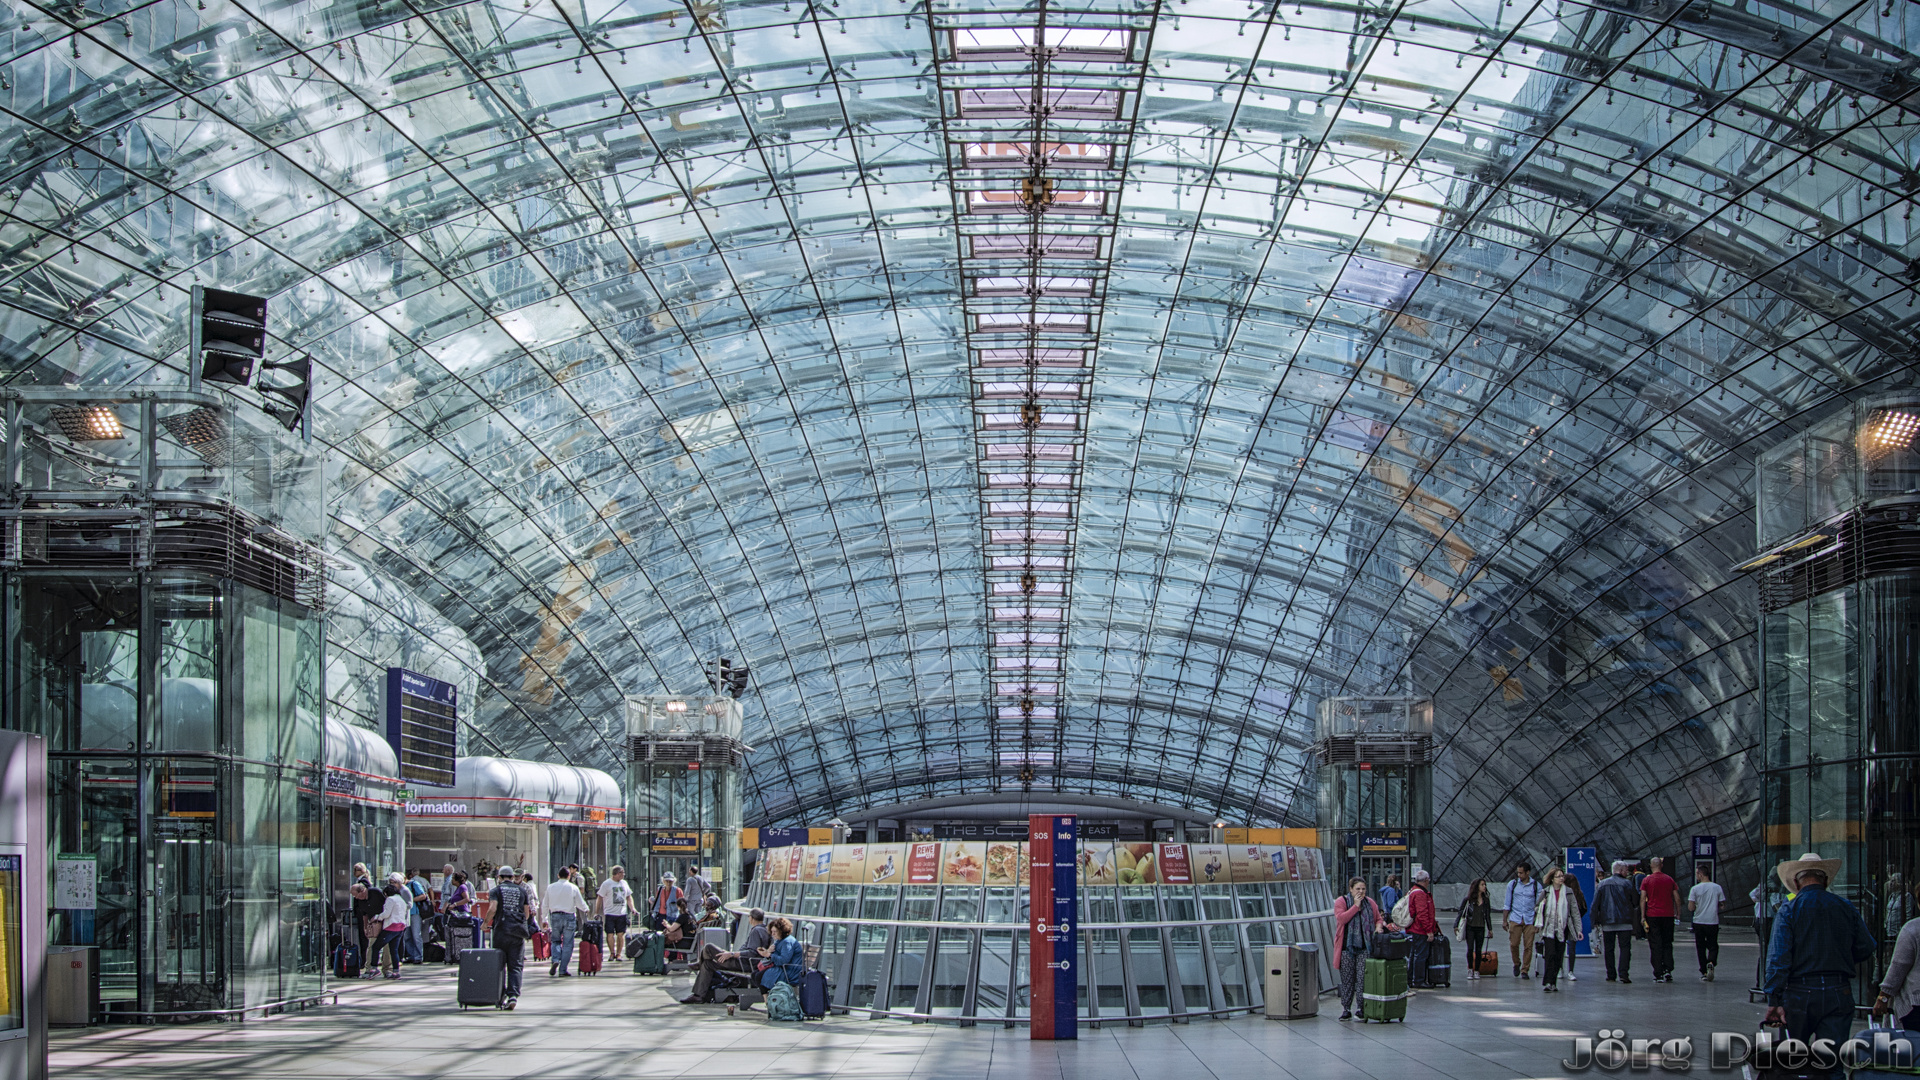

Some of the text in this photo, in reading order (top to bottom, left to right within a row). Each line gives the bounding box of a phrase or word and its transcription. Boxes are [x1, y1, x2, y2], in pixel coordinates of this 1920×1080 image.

[768, 828, 782, 836] 6-7
[1088, 826, 1111, 835] EAST
[1034, 832, 1048, 840] SOS
[1058, 832, 1072, 840] Info
[917, 844, 934, 855] REWE
[1165, 846, 1182, 855] REWE
[1292, 970, 1300, 1012] Abfall
